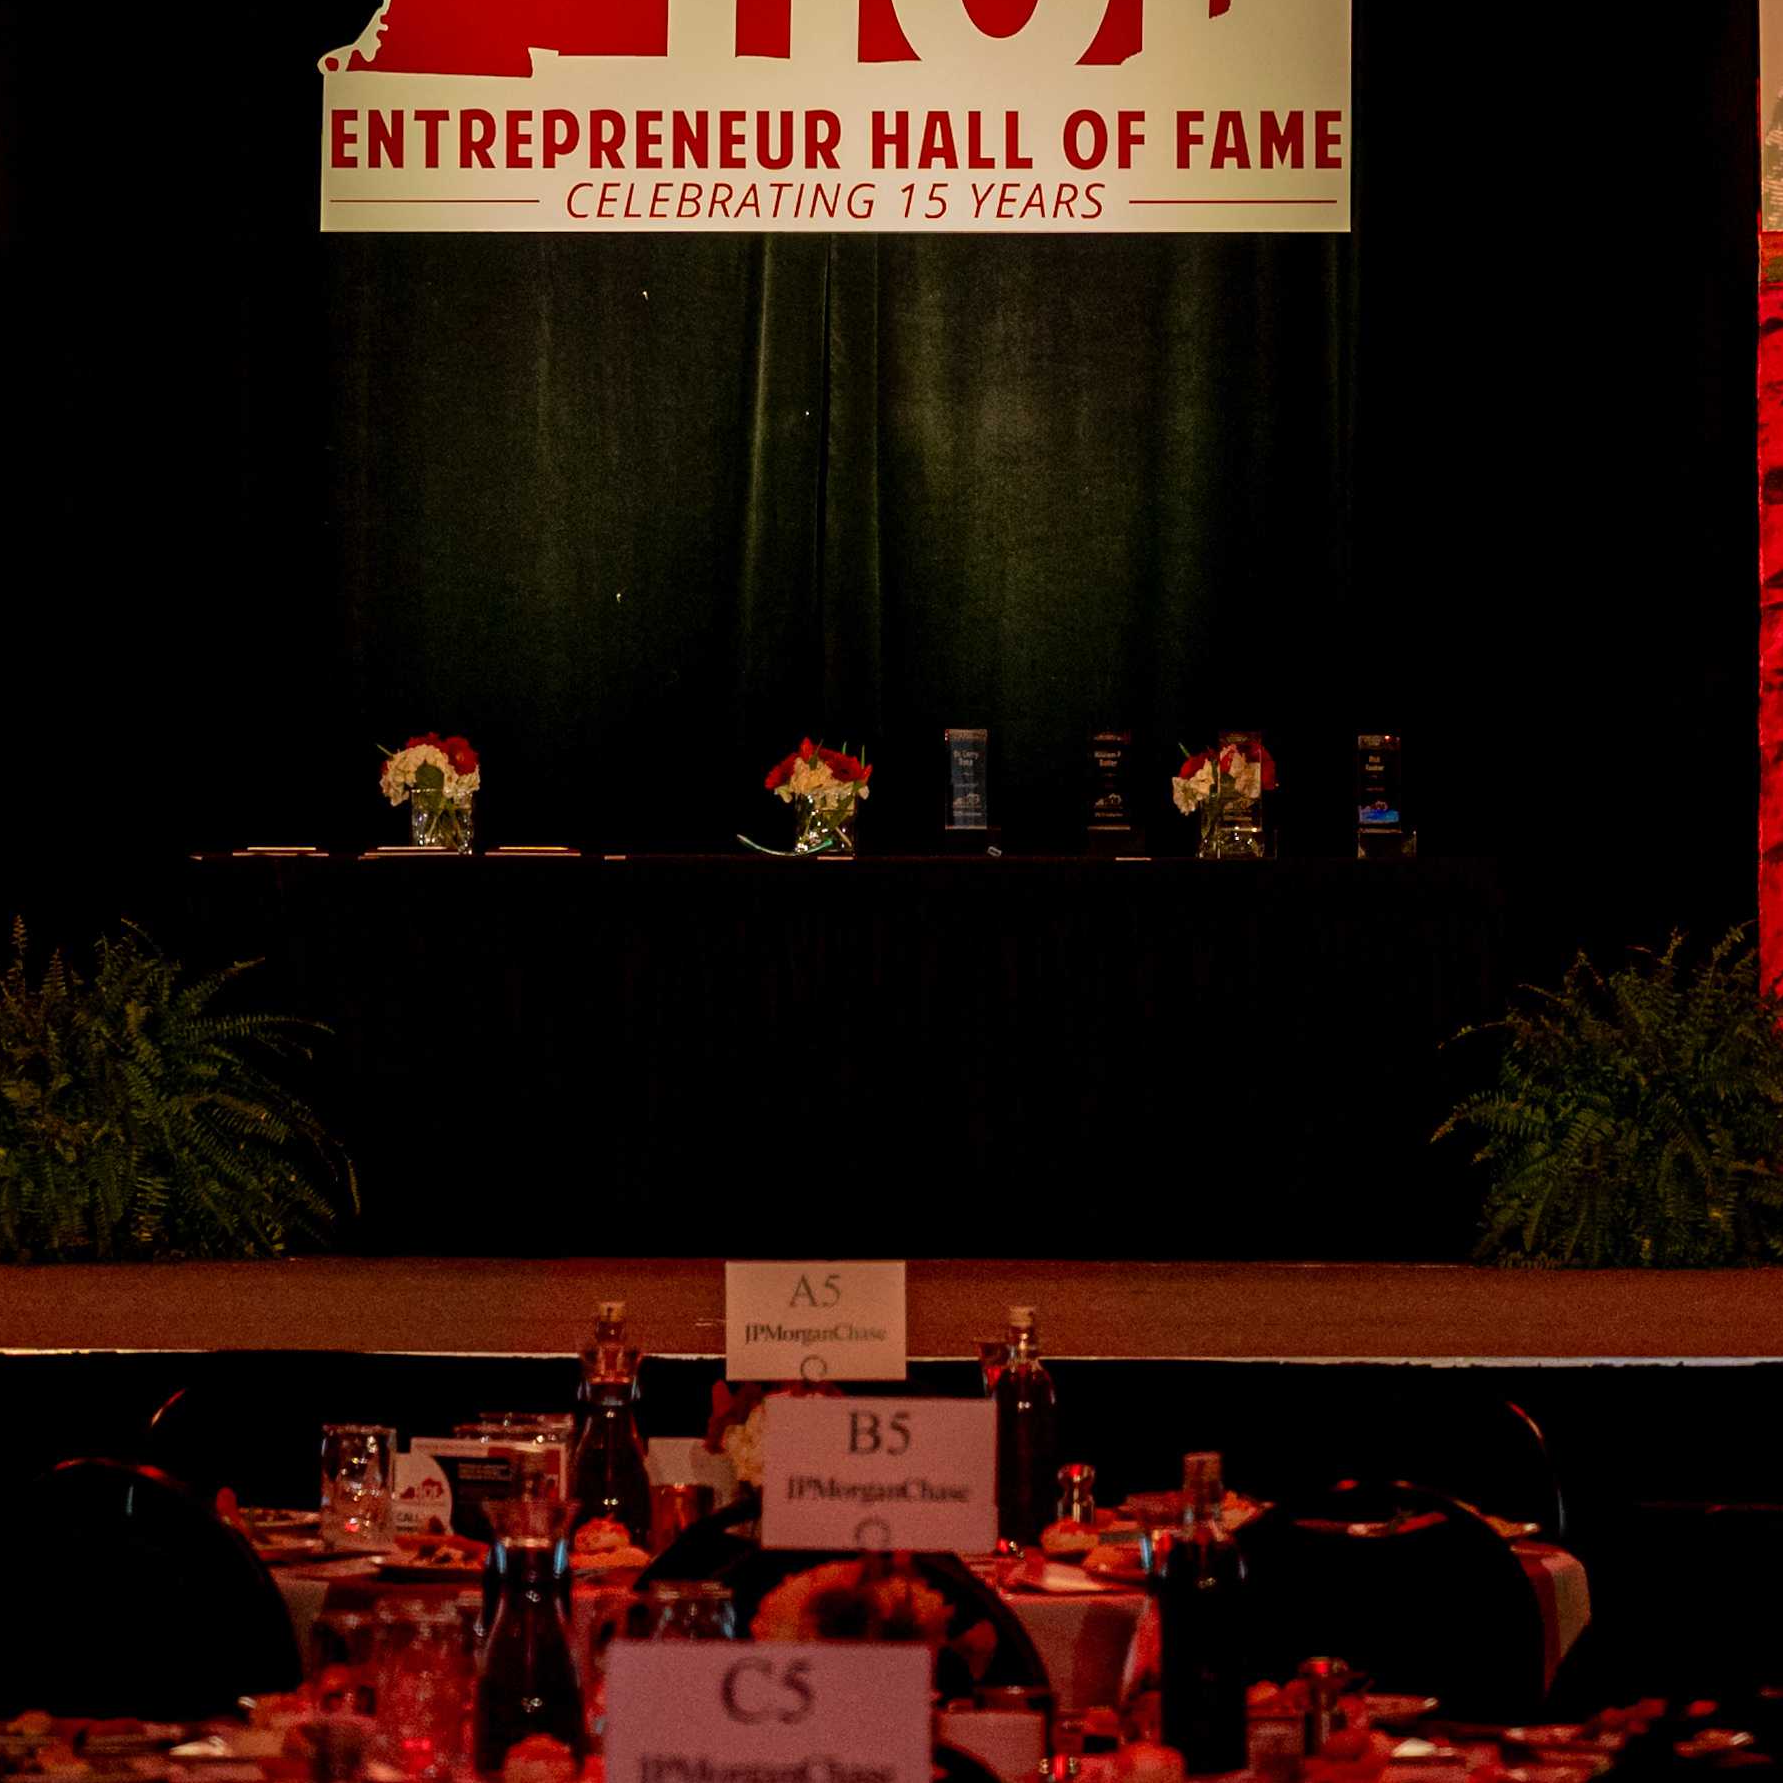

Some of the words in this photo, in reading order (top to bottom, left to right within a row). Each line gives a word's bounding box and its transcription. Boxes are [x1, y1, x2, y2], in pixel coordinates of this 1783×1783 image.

[330, 108, 841, 169] ENTREPRENEUR
[871, 110, 1033, 169] HALL
[1063, 109, 1146, 170] OF
[1176, 110, 1343, 169] FAME
[566, 182, 877, 219] CELEBRATING
[899, 183, 948, 218] 15
[970, 182, 1105, 219] YEARS
[789, 1274, 842, 1308] A5
[744, 1324, 887, 1345] JPMorganChase
[847, 1410, 912, 1456] B5
[786, 1476, 970, 1504] JPMorganChase
[720, 1655, 815, 1726] C5
